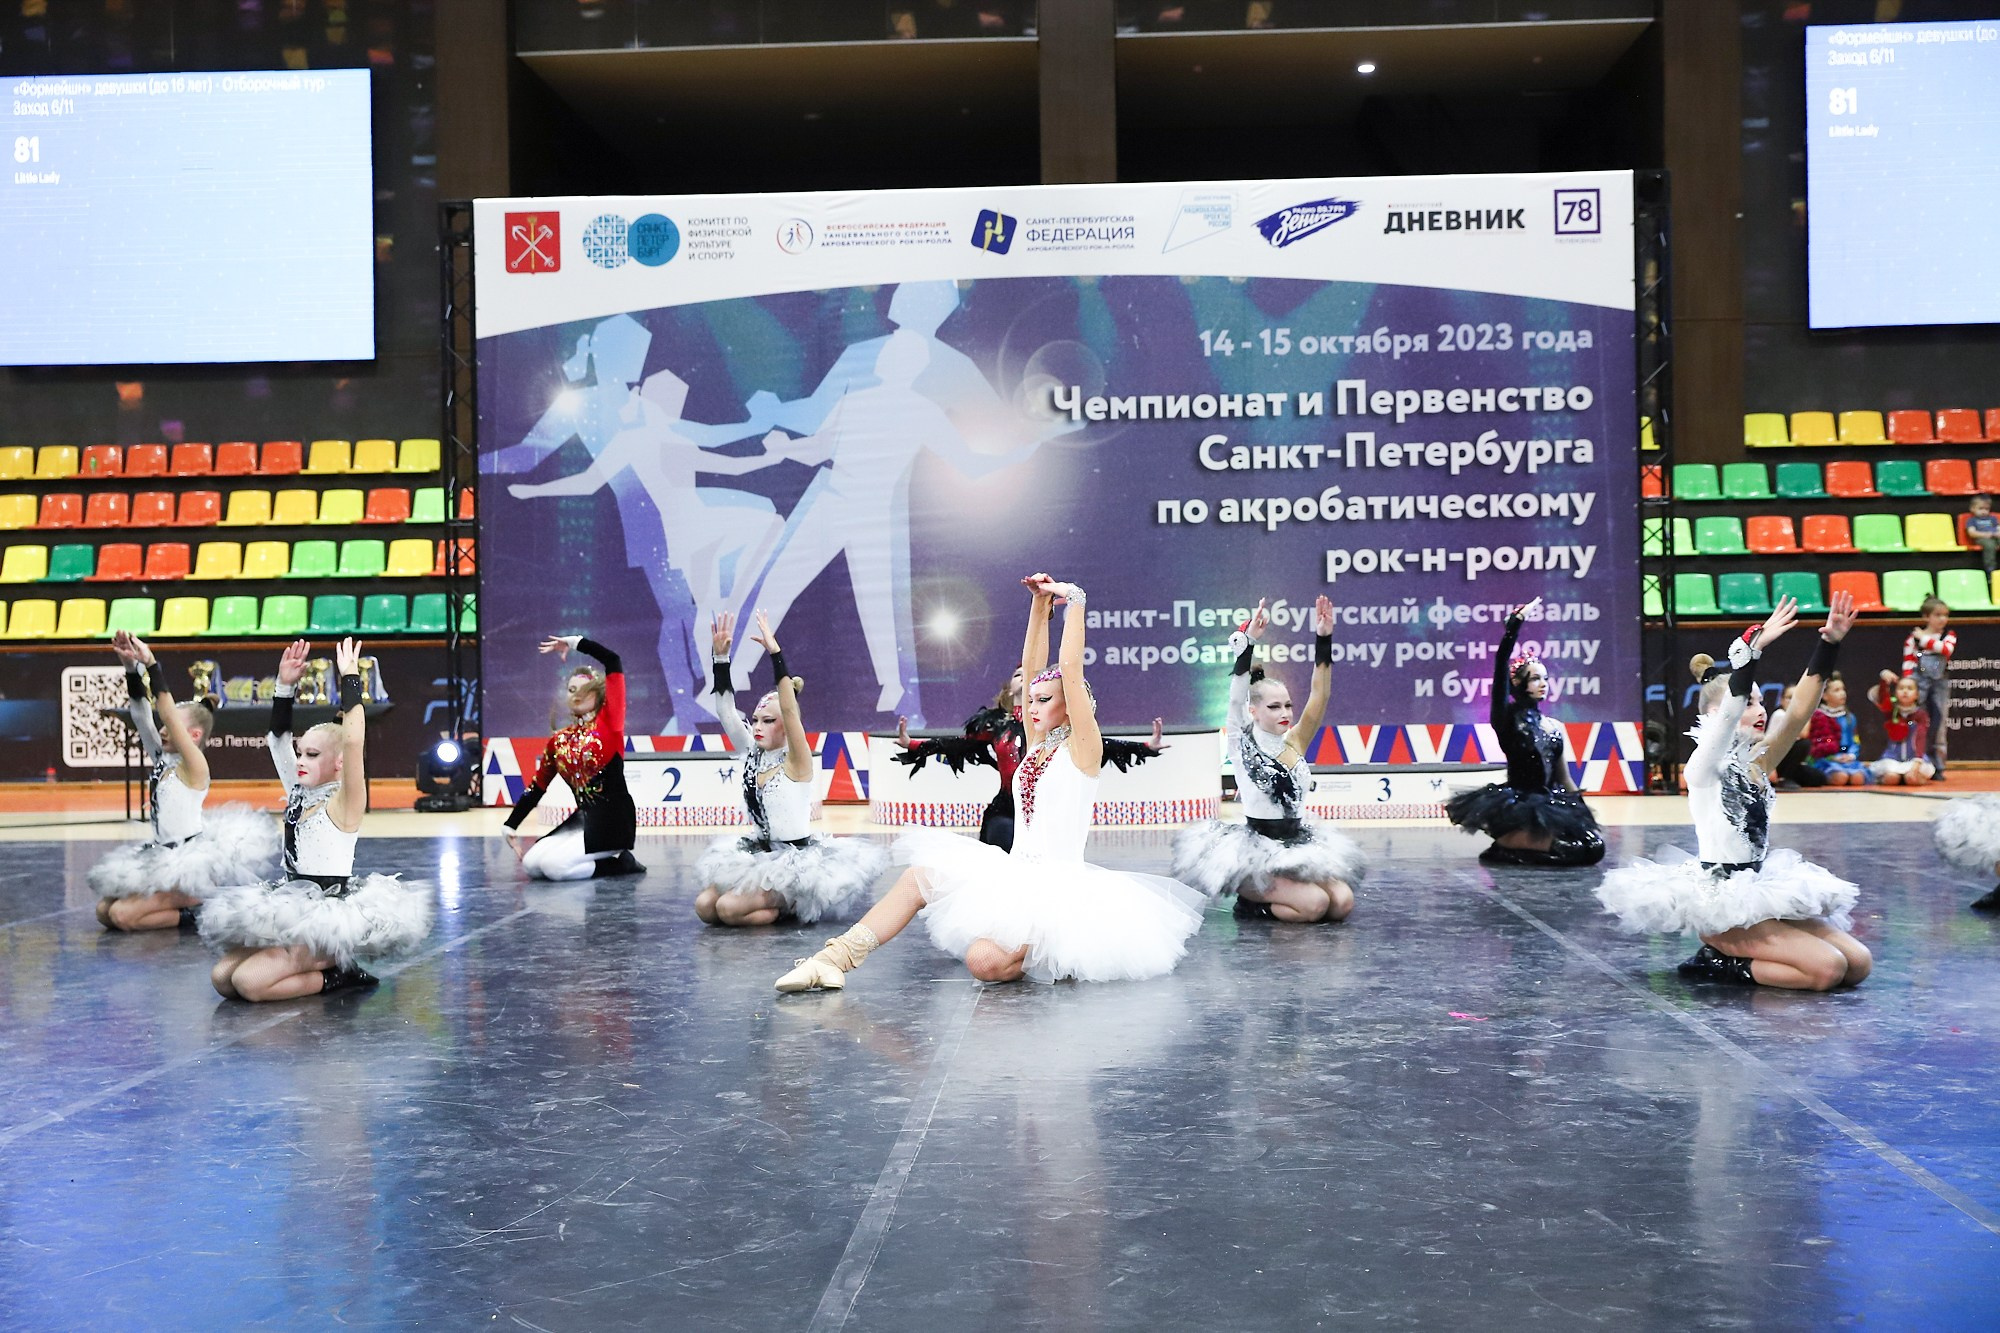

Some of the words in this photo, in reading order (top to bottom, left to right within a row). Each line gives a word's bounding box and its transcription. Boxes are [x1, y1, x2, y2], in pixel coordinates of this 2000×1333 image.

[13, 100, 50, 117] Заход
[51, 99, 74, 116] 6/11
[1829, 87, 1857, 115] 81
[14, 136, 39, 163] 81
[688, 217, 731, 227] КОМИТЕТ
[734, 216, 748, 226] ПО
[1026, 215, 1135, 226] САНКТ-ПЕТЕРБУРГСКАЯ
[1384, 208, 1525, 234] ДНЕВНИК
[1562, 199, 1592, 224] 78
[688, 226, 752, 238] ФИЗИЧЕСКОЙ
[688, 240, 731, 249] КУЛЬТУРЕ
[1026, 226, 1135, 244] ФЕДЕРАЦИЯ
[698, 251, 735, 261] СПОРТУ
[1200, 329, 1234, 357] 14
[1259, 328, 1291, 356] 15
[1299, 327, 1429, 359] октября
[1437, 323, 1514, 352] 2023
[1522, 329, 1593, 353] года
[1053, 385, 1288, 421] Чемпионат
[1299, 392, 1323, 416] и
[1336, 379, 1594, 423] Первенство
[1199, 429, 1594, 475] Санкт-Петербурга
[1157, 498, 1208, 524] по
[1219, 485, 1596, 531] акробатическому
[1326, 544, 1597, 583] рок-н-роллу
[1063, 597, 1420, 633] анкт-Петебугский
[1105, 637, 1387, 671] акробатчесому
[1415, 678, 1434, 697] и
[1441, 669, 1600, 703] бугуги
[662, 767, 683, 802] 2
[1377, 777, 1392, 802] 3
